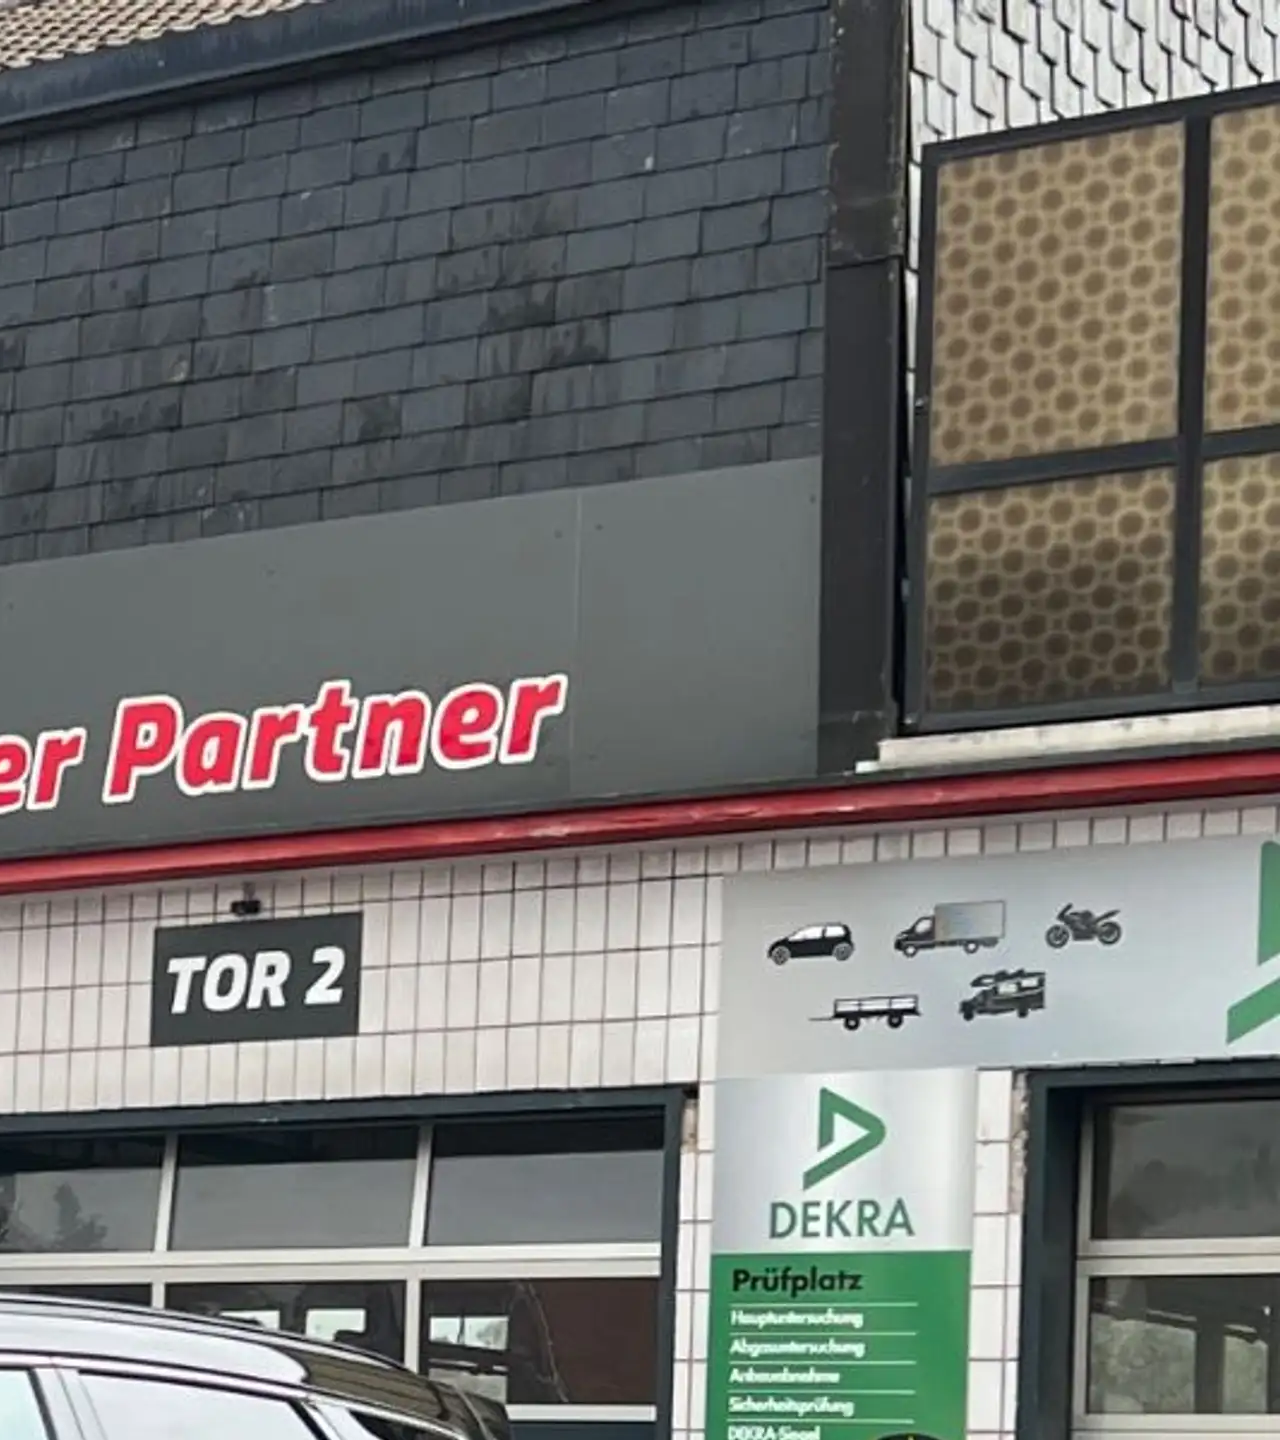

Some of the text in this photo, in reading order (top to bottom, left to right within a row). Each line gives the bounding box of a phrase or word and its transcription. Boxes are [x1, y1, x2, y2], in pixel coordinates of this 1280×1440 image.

[102, 672, 568, 804] Partner
[165, 946, 346, 1015] TOR 2
[769, 1197, 916, 1240] DEKRA
[732, 1265, 863, 1298] Prüfplatz
[730, 1308, 864, 1329] Hauptuntersuchung
[729, 1338, 865, 1358] Abgasuntersuchung
[728, 1396, 855, 1417] Sicherheitsprüfung
